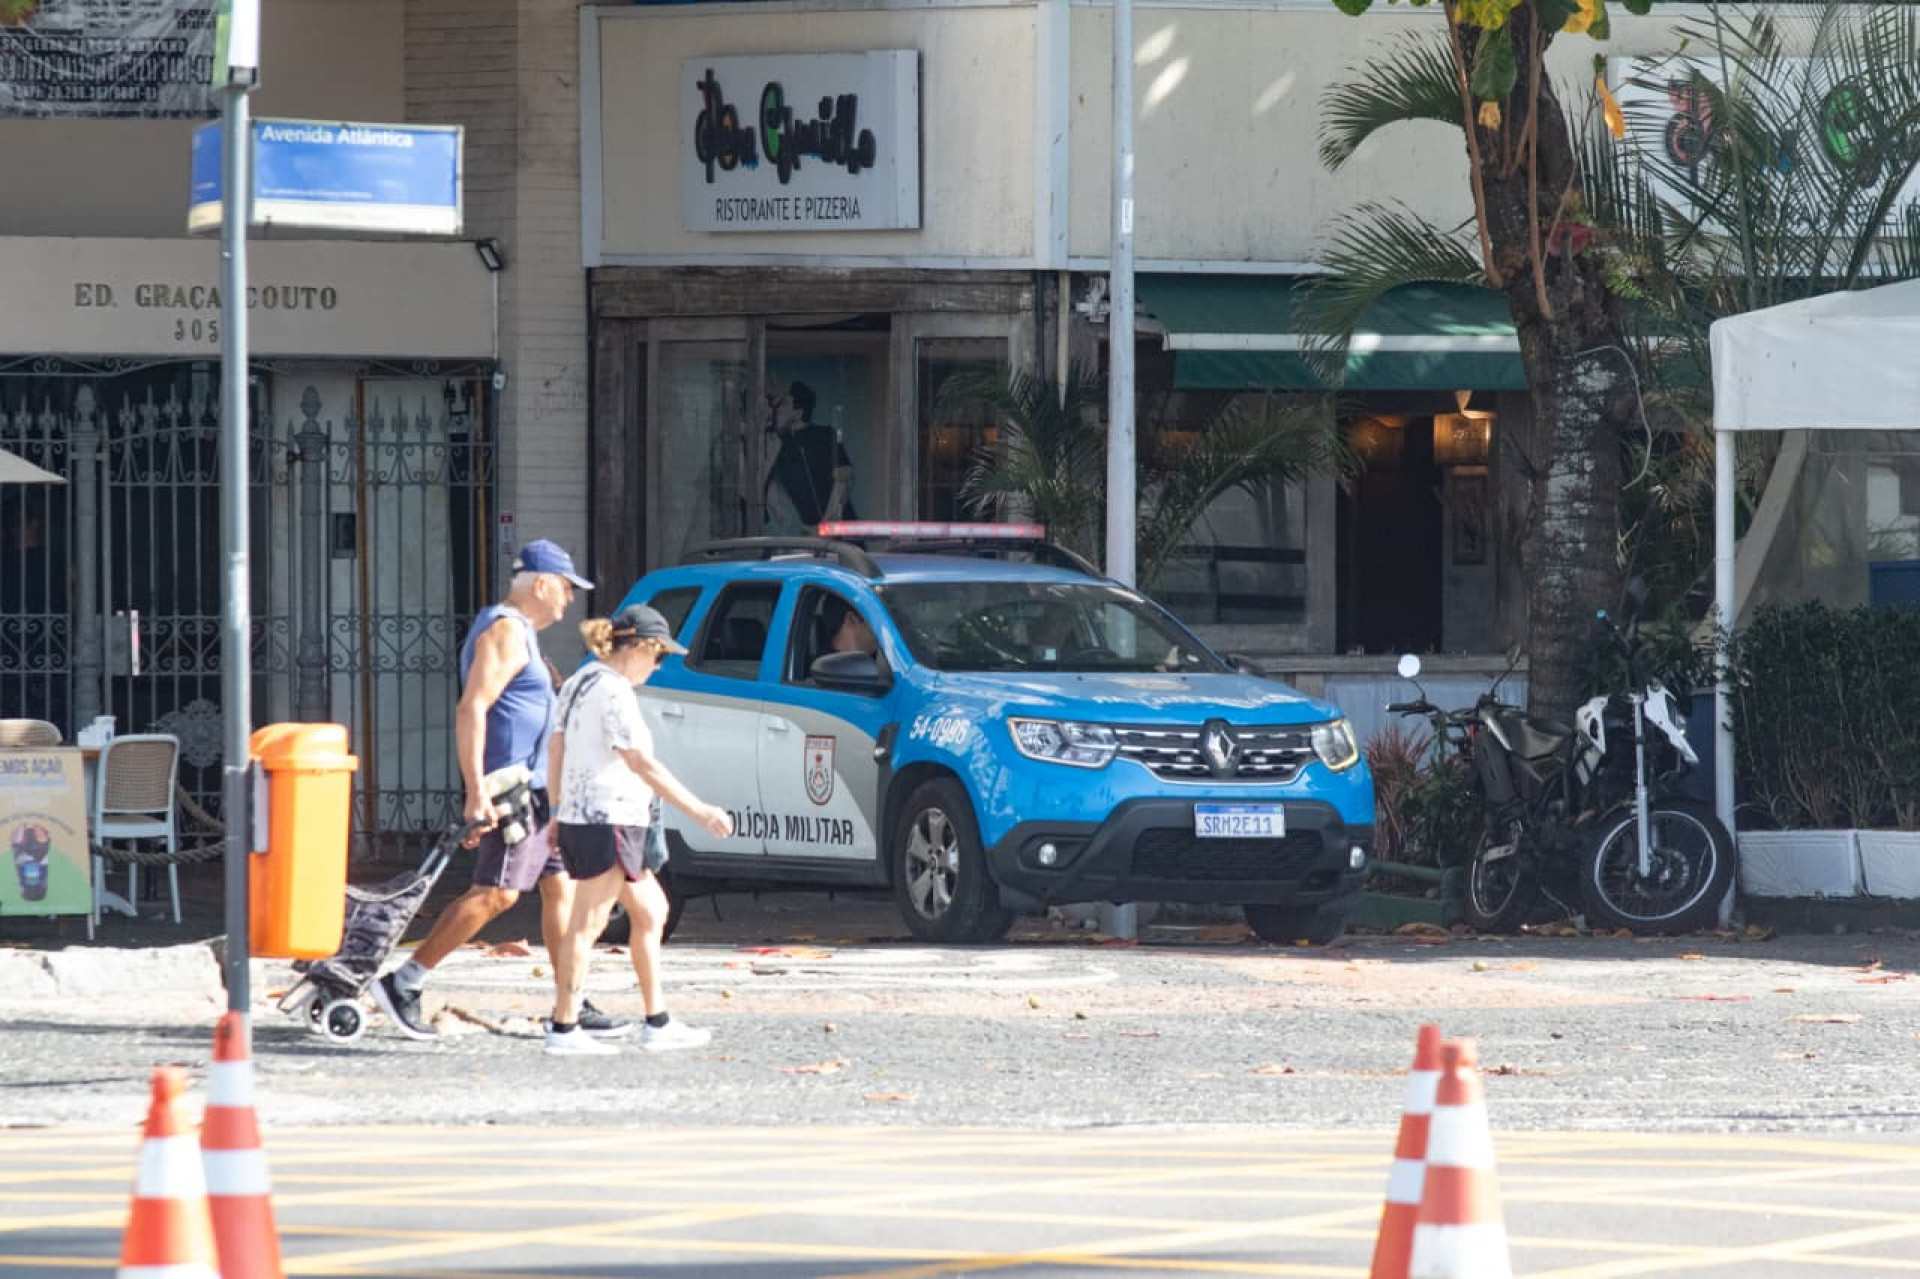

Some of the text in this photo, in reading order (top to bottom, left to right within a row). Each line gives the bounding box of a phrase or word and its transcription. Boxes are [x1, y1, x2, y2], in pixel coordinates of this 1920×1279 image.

[261, 124, 414, 148] Avenida Atlântica
[716, 197, 861, 221] RISTORANTE E PIZZERIA
[74, 283, 337, 310] ED. GRAÇA COUTO
[728, 805, 853, 845] OLÍCIA MILITAR
[1203, 815, 1273, 835] SRM2E11
